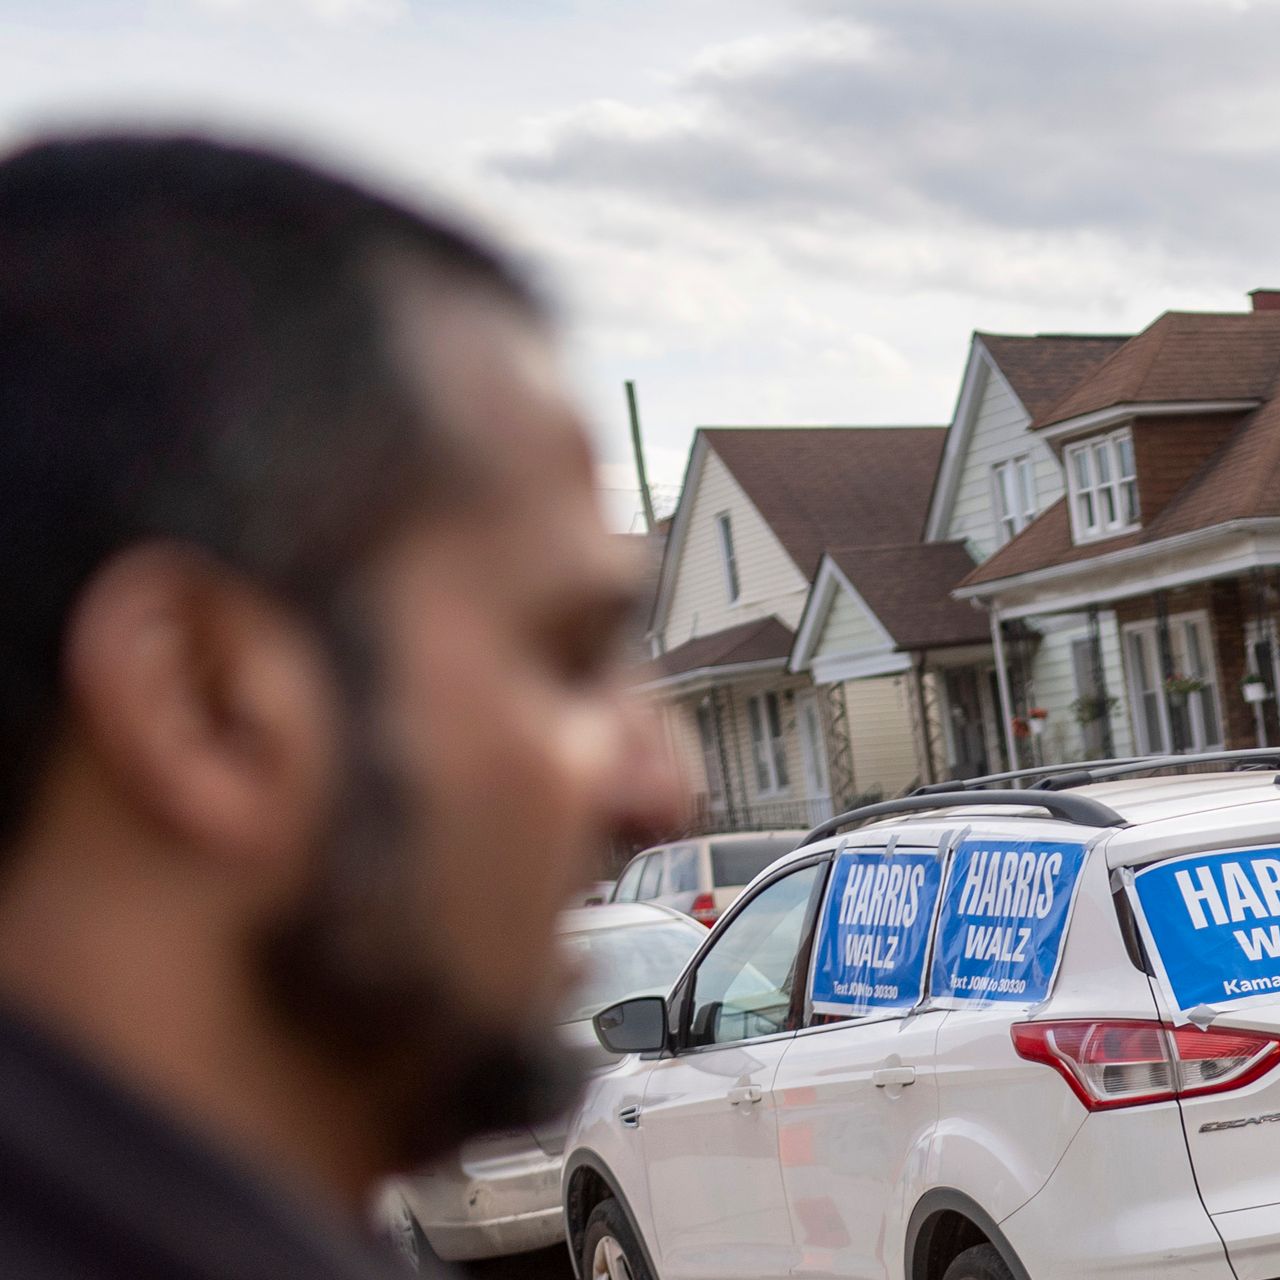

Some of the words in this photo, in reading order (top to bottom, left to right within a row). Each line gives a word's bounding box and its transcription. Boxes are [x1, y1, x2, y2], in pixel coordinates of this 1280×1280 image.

[839, 864, 925, 928] HARRIS
[958, 851, 1063, 919] HARRIS
[845, 934, 899, 969] WALZ
[964, 925, 1032, 963] WALZ
[833, 980, 848, 995] Text
[848, 982, 865, 997] JOIN
[874, 984, 898, 1000] 30330
[951, 974, 968, 989] Text
[968, 975, 988, 991] JOIN
[988, 976, 998, 992] to
[998, 977, 1026, 994] 30330
